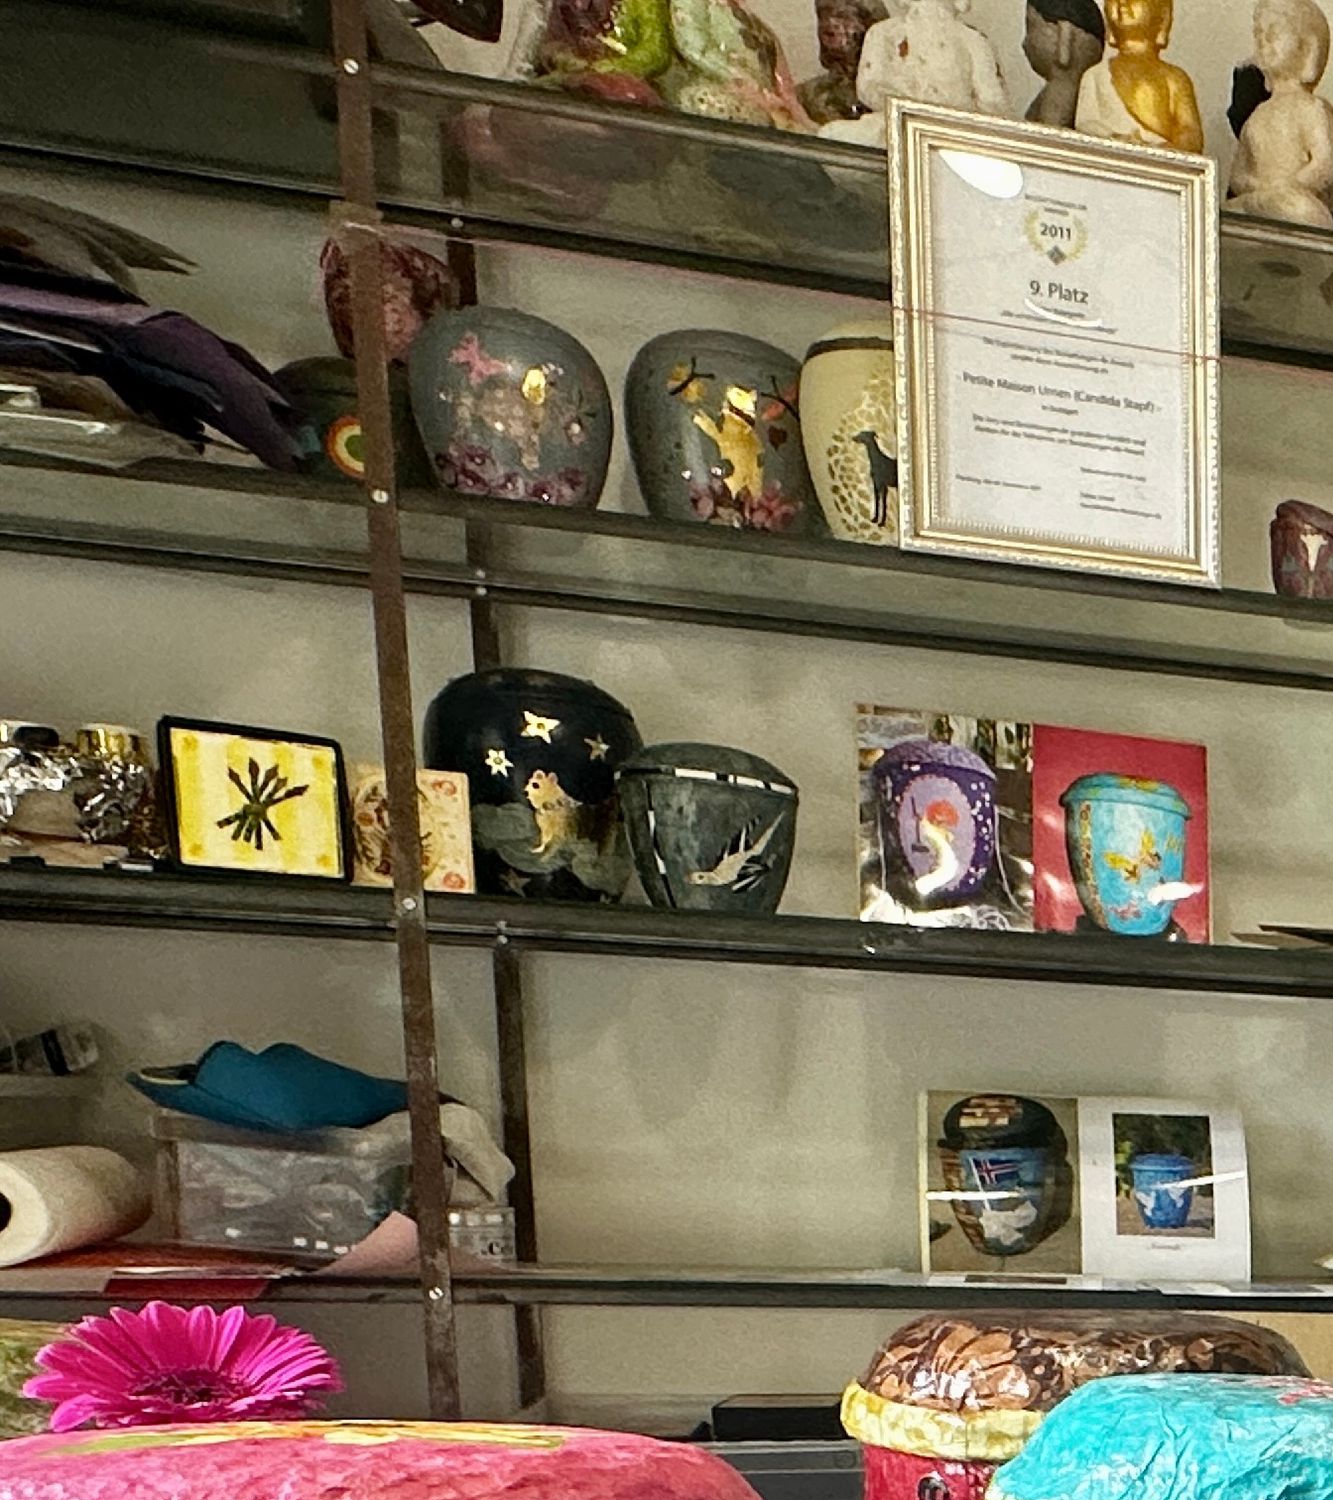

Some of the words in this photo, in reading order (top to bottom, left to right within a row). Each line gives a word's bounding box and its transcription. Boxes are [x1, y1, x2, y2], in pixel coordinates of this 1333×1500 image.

[1040, 222, 1071, 241] 2011
[1029, 280, 1043, 297] 9.
[1048, 282, 1089, 304] Platz
